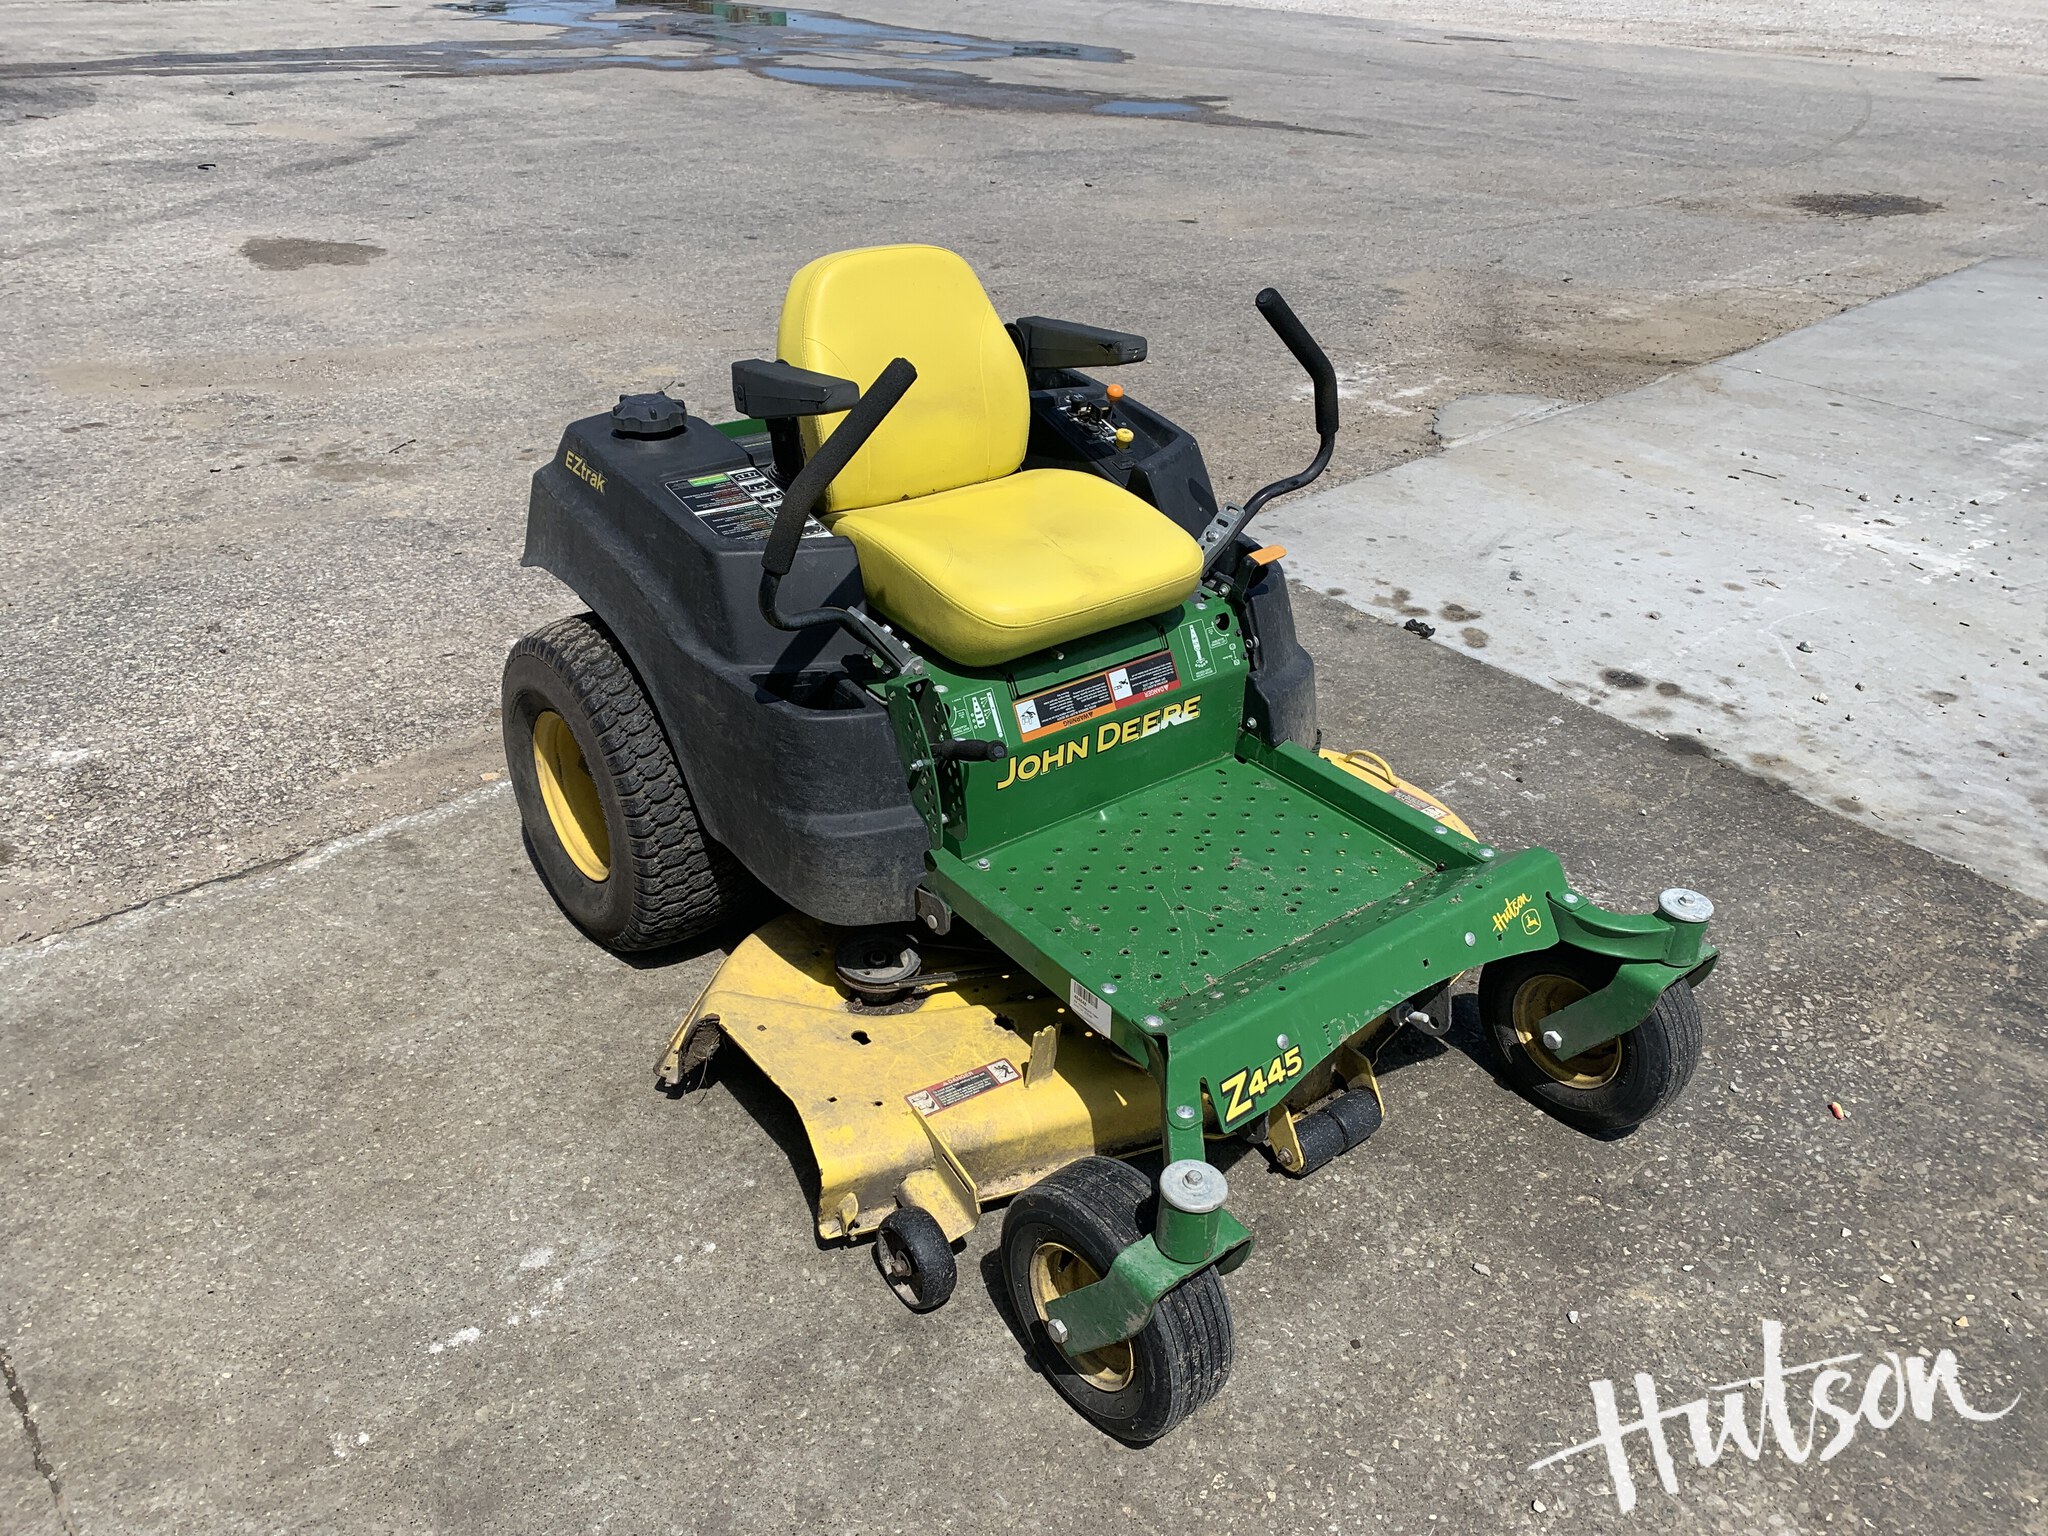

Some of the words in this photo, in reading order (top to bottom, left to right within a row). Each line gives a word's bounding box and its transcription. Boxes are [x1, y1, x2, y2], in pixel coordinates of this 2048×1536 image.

[565, 450, 607, 494] EZtrak
[1143, 684, 1164, 699] DANGER
[1062, 713, 1088, 728] WARNING
[996, 735, 1090, 790] JOHN
[1097, 695, 1201, 753] DEERE
[1492, 893, 1532, 932] Hutson
[1221, 1045, 1303, 1125] Z445
